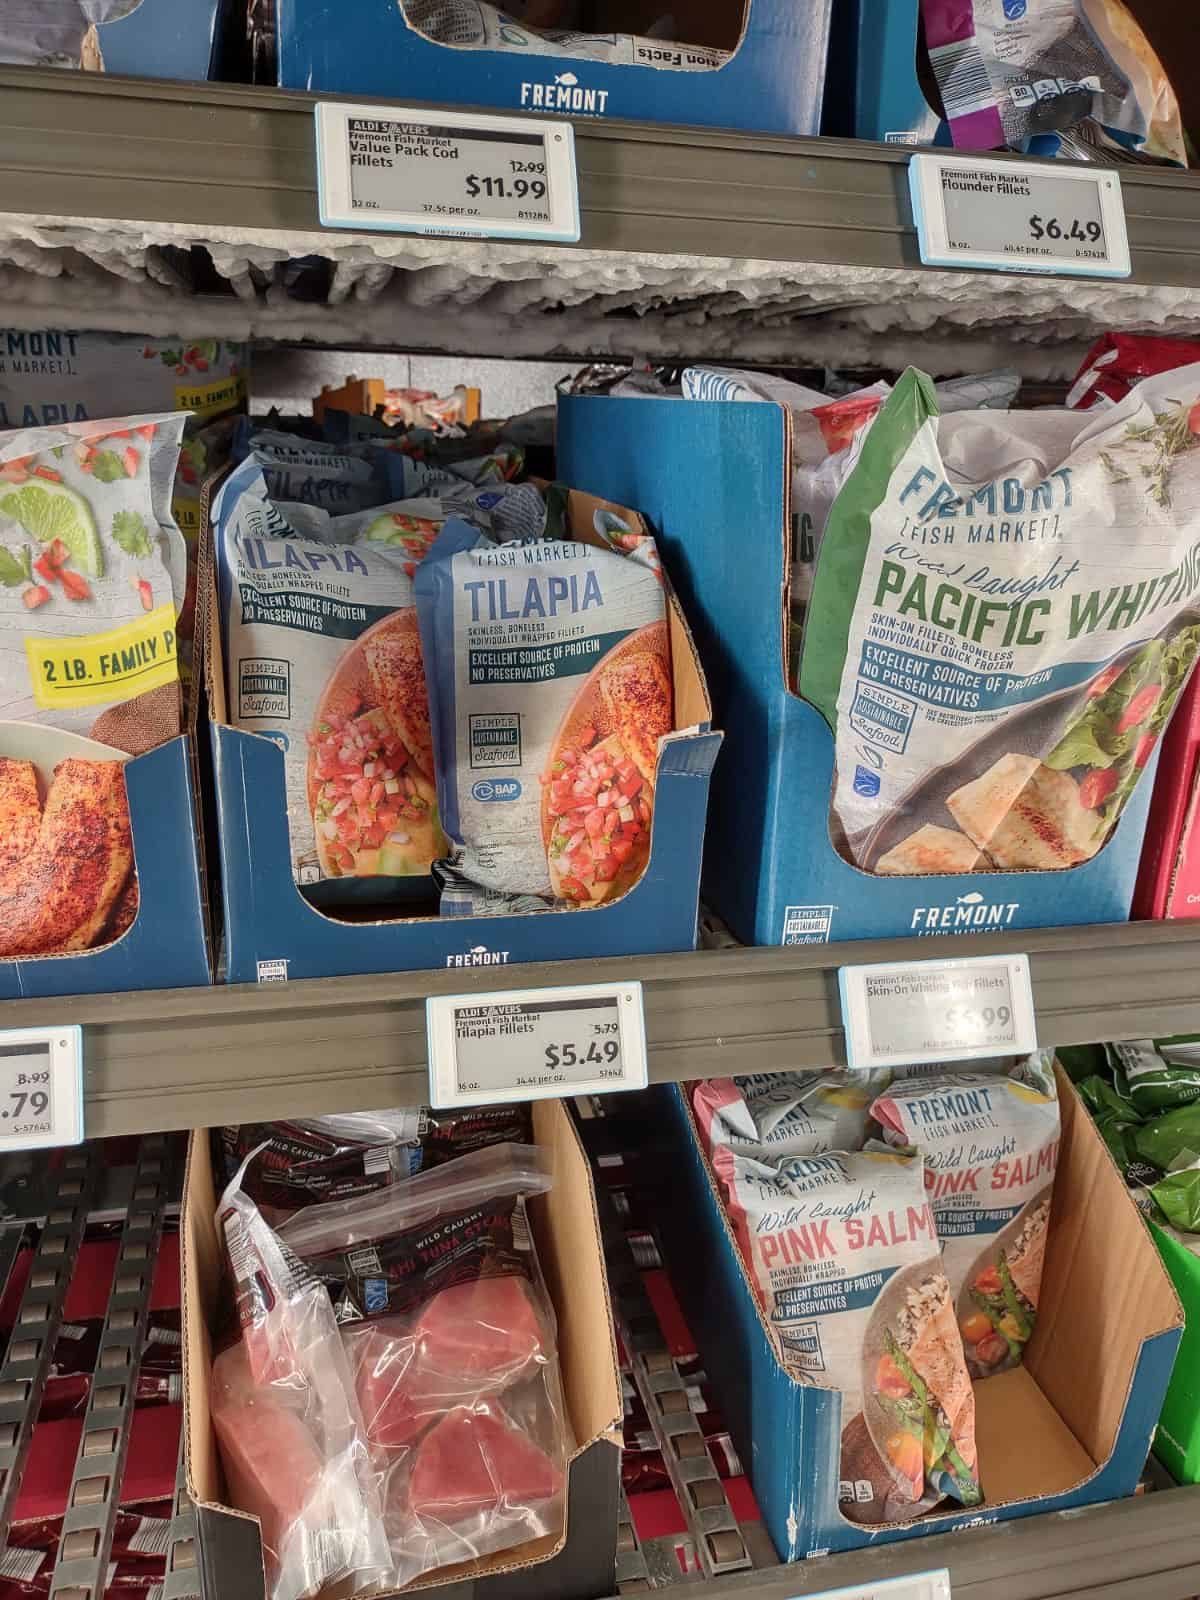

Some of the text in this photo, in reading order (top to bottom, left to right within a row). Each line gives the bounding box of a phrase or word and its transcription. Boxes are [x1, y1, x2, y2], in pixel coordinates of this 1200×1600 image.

[637, 48, 682, 66] Facts
[521, 82, 609, 113] FREMONT
[1014, 87, 1028, 97] 80
[353, 120, 381, 133] ALDI
[350, 132, 452, 148] Fremont Fish Market
[350, 140, 459, 159] Value Pack Cod
[351, 154, 393, 168] Fillets
[510, 160, 545, 174] 12.99
[466, 174, 546, 199] $11.99
[940, 169, 1029, 185] Fremont Fish Market
[942, 178, 1031, 196] Flounder Fillets
[467, 208, 481, 216] oz.
[1029, 214, 1101, 242] $6.49
[235, 537, 369, 576] ILAPIA
[884, 540, 1080, 610] Wild Caught
[242, 587, 366, 621] EXCELLENT SOURCE OF PROTEIN
[463, 569, 604, 621] TILAPIA
[872, 559, 1051, 648] PACIFIC
[258, 608, 323, 631] PRESERVATIVES
[508, 622, 545, 633] BONELESS
[521, 631, 555, 643] WRAPPED
[558, 625, 585, 639] FILLETS
[870, 612, 915, 635] SKIN-ON
[961, 641, 1014, 661] BONELESS
[472, 639, 600, 665] EXCELLENT SOURCE OF PROTEIN
[867, 625, 1014, 671] INDIVIDUALLY QUICK FROZEN
[43, 660, 56, 682] 2
[64, 655, 93, 681] LB.
[99, 642, 158, 678] FAMILY
[244, 662, 285, 675] SIMPLE
[472, 663, 556, 681] NO PRESERVATIVES
[866, 646, 1054, 694] EXCELLENT SOURCE OF PROTEIN
[863, 660, 980, 708] NO PRESERVATIVES
[863, 687, 910, 715] SIMPLE
[857, 698, 905, 733] SUSTAINABLE
[856, 718, 900, 747] Seafood
[475, 747, 514, 762] Seafood
[495, 783, 517, 794] BAP
[911, 903, 1019, 928] FREMONT
[447, 951, 510, 968] FREMONT
[867, 983, 909, 997] Skin-On
[973, 976, 1005, 991] Fillets
[455, 1013, 541, 1027] Fremont Fish Market
[459, 1006, 482, 1018] ALDI
[456, 1023, 535, 1039] Tilapia Fillets
[594, 1023, 618, 1034] 5.79
[545, 1041, 619, 1069] $5.49
[18, 1071, 50, 1086] 8.99
[906, 1087, 993, 1126] FREMONT
[924, 1135, 1016, 1168] Wild Caught
[924, 1167, 983, 1199] PINK
[756, 1188, 877, 1233] Wild Caught
[416, 1211, 483, 1249] WILD CAUGHT
[420, 1235, 460, 1263] TUNA
[758, 1219, 837, 1269] PINK
[812, 1282, 844, 1298] SOURCE
[843, 1280, 855, 1292] OF
[854, 1273, 884, 1292] PROTEIN
[786, 1296, 847, 1317] PRESERVATIVES
